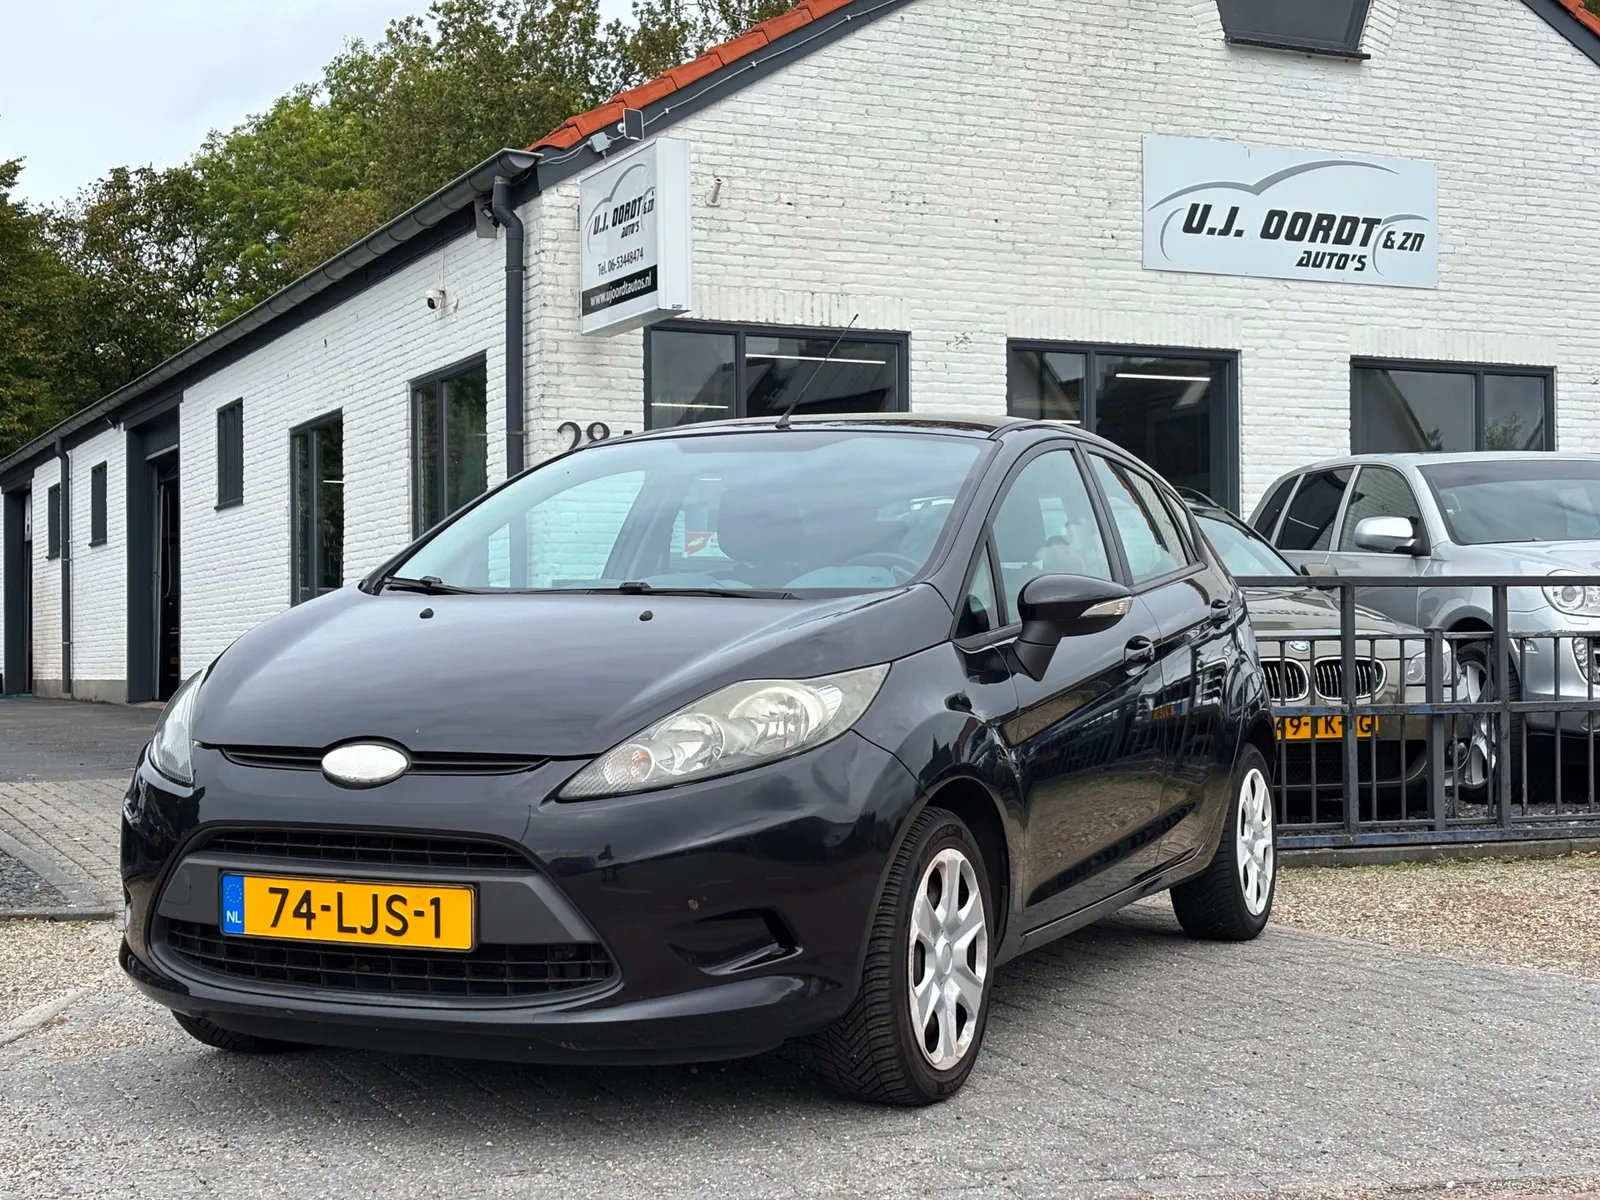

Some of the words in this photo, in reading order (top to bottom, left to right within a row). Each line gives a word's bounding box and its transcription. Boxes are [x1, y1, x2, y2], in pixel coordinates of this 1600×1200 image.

[592, 213, 609, 236] U.J.
[611, 195, 643, 227] OORDT
[1182, 203, 1245, 238] U.J.
[1259, 209, 1382, 247] OORDT
[597, 260, 607, 277] Tel.
[607, 247, 644, 272] 06-53448474
[1295, 250, 1367, 272] AUTO'S
[589, 271, 652, 307] www.ujoordtautos.nl
[226, 910, 242, 924] NL
[268, 886, 441, 939] 74-LJS-1
